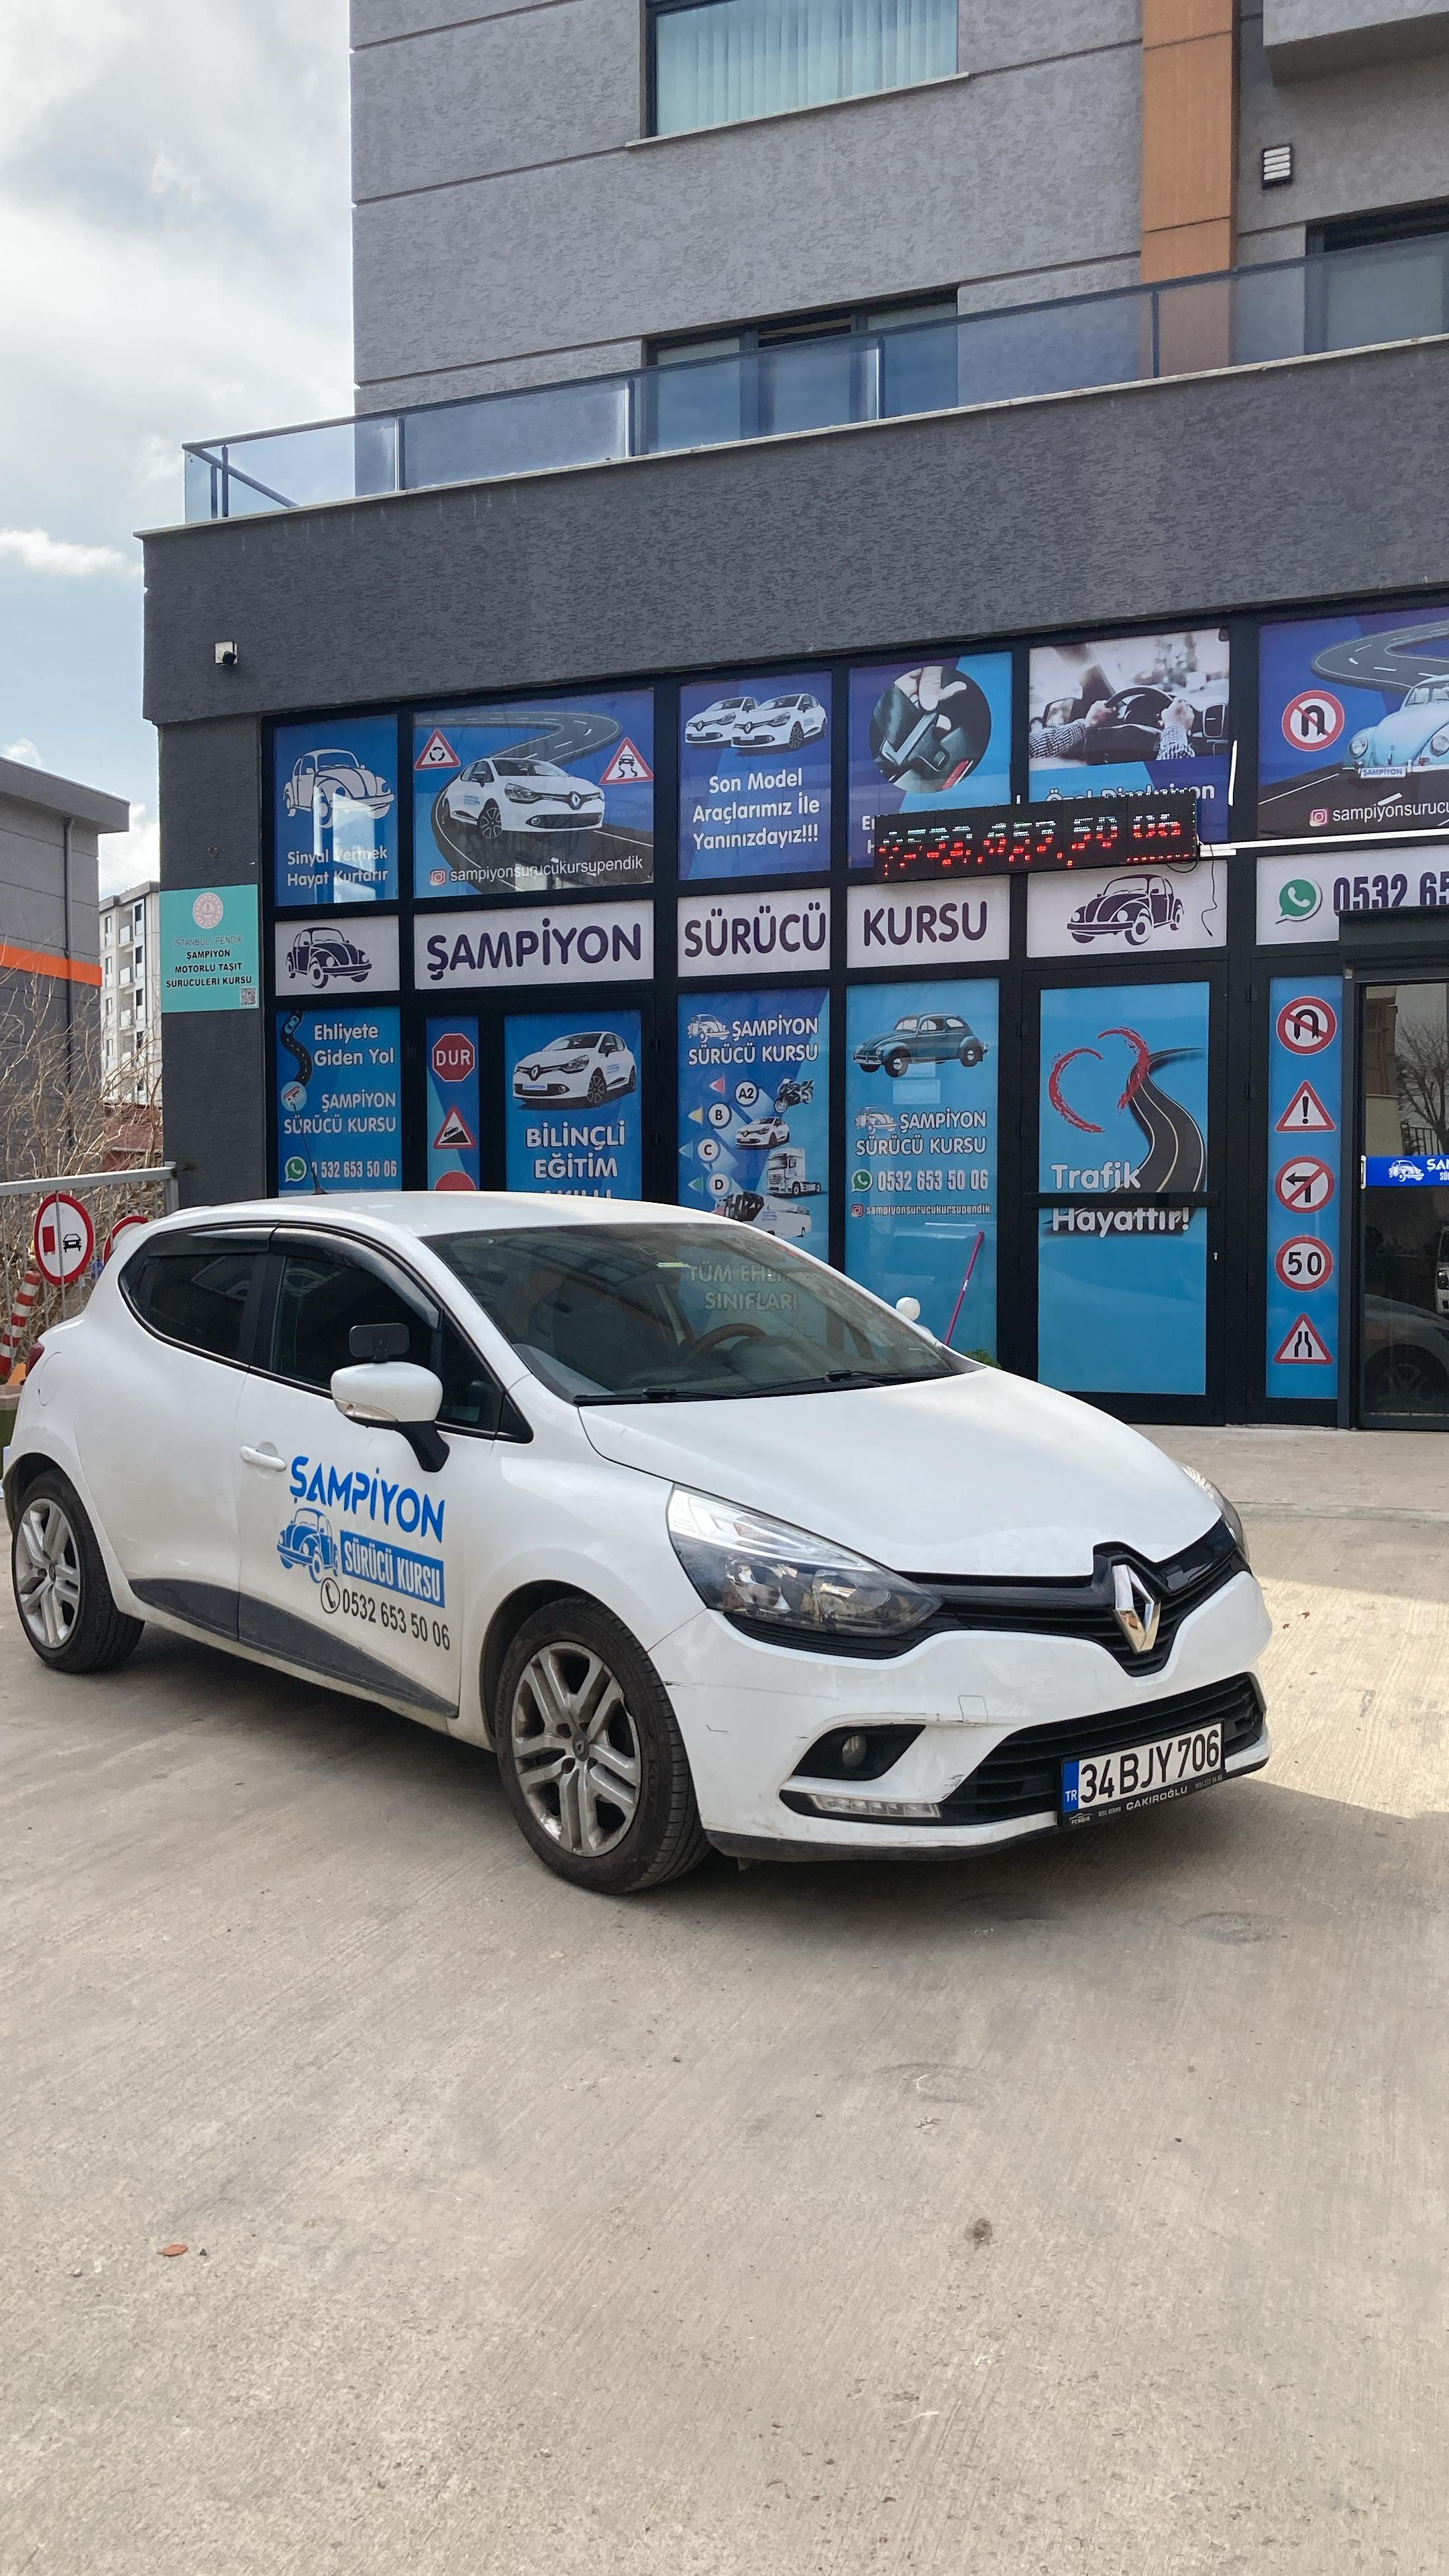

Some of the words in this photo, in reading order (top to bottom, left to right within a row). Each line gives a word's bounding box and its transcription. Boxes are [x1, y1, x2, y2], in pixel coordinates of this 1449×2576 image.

[709, 775, 741, 794] Son
[747, 767, 802, 790] Model
[692, 801, 792, 825] Araçlarımız
[798, 792, 820, 814] İle
[693, 823, 818, 851] Yanınızdayız!!!
[287, 849, 329, 867] Sinyal
[287, 871, 329, 889] Hayat
[335, 869, 388, 883] Kurtarır
[427, 917, 641, 981] ŞAMPİYON
[684, 902, 826, 957] SÜRÜCÜ
[863, 901, 987, 947] KURSU
[175, 964, 215, 973] MOTORLU
[219, 963, 242, 972] TAŞIT
[223, 976, 252, 985] KURSU
[314, 1023, 379, 1044] Ehliyete
[732, 1014, 818, 1041] ŞAMPİYON
[314, 1049, 363, 1067] Giden
[369, 1046, 394, 1065] Yol
[436, 1051, 471, 1066] DUR
[688, 1042, 755, 1065] SÜRÜCÜ
[762, 1044, 818, 1063] KURSU
[321, 1088, 396, 1112] ŞAMPİYON
[739, 1088, 754, 1099] A2
[284, 1114, 342, 1134] SÜRÜCÜ
[347, 1116, 396, 1133] KURSU
[715, 1110, 722, 1120] B
[900, 1107, 987, 1134] ŞAMPİYON
[526, 1119, 625, 1150] BİLİNÇLİ
[856, 1134, 924, 1156] SÜRÜCÜ
[930, 1136, 986, 1154] KURSU
[704, 1144, 712, 1156] C
[321, 1161, 340, 1178] 532
[343, 1161, 363, 1177] 653
[367, 1161, 380, 1177] 50
[384, 1160, 397, 1177] 06
[535, 1152, 618, 1178] EĞİTİM
[1051, 1161, 1141, 1189] Trafik
[715, 1179, 724, 1190] D
[877, 1171, 912, 1191] 0532
[916, 1170, 943, 1191] 653
[947, 1169, 966, 1191] 50
[970, 1169, 989, 1190] 06
[1053, 1208, 1189, 1238] Hayattır!
[1287, 1251, 1323, 1276] 50
[704, 1291, 799, 1311] SINIFLARI
[344, 1535, 394, 1586] SÜRÜCÜ
[397, 1556, 441, 1602] KURSU
[343, 1588, 376, 1623] 0532
[381, 1601, 407, 1633] 653
[411, 1612, 428, 1642] 50
[433, 1621, 451, 1651] 06
[1065, 1789, 1077, 1803] TR
